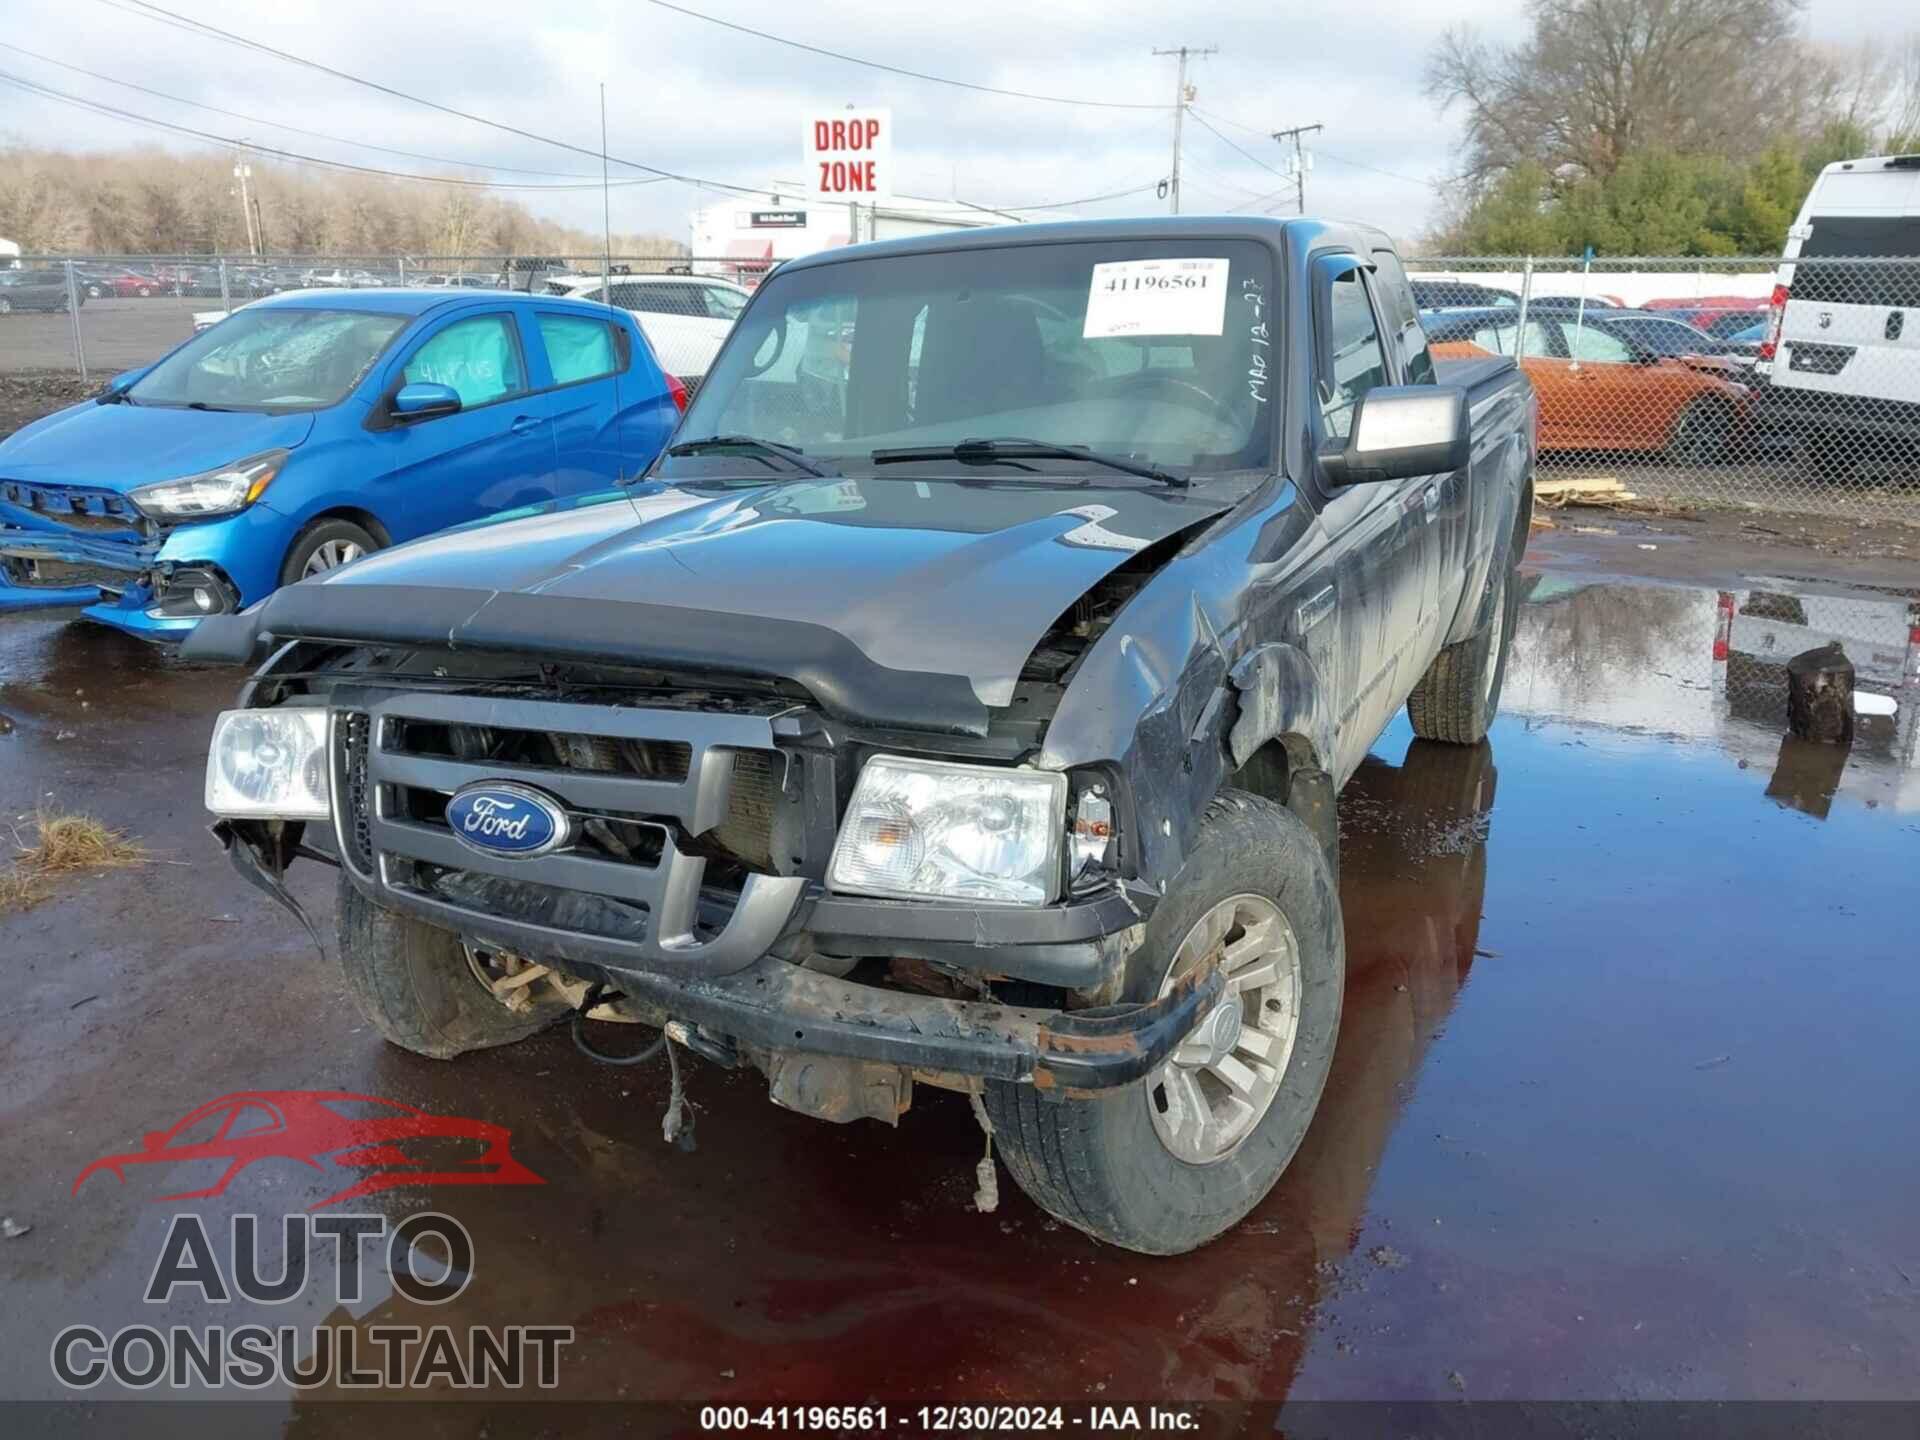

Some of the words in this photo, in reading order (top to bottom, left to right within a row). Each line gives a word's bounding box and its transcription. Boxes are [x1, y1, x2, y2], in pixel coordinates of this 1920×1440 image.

[815, 118, 879, 151] DROP
[820, 161, 876, 192] ZONE
[1104, 275, 1207, 292] 41196561
[463, 796, 531, 840] Ford
